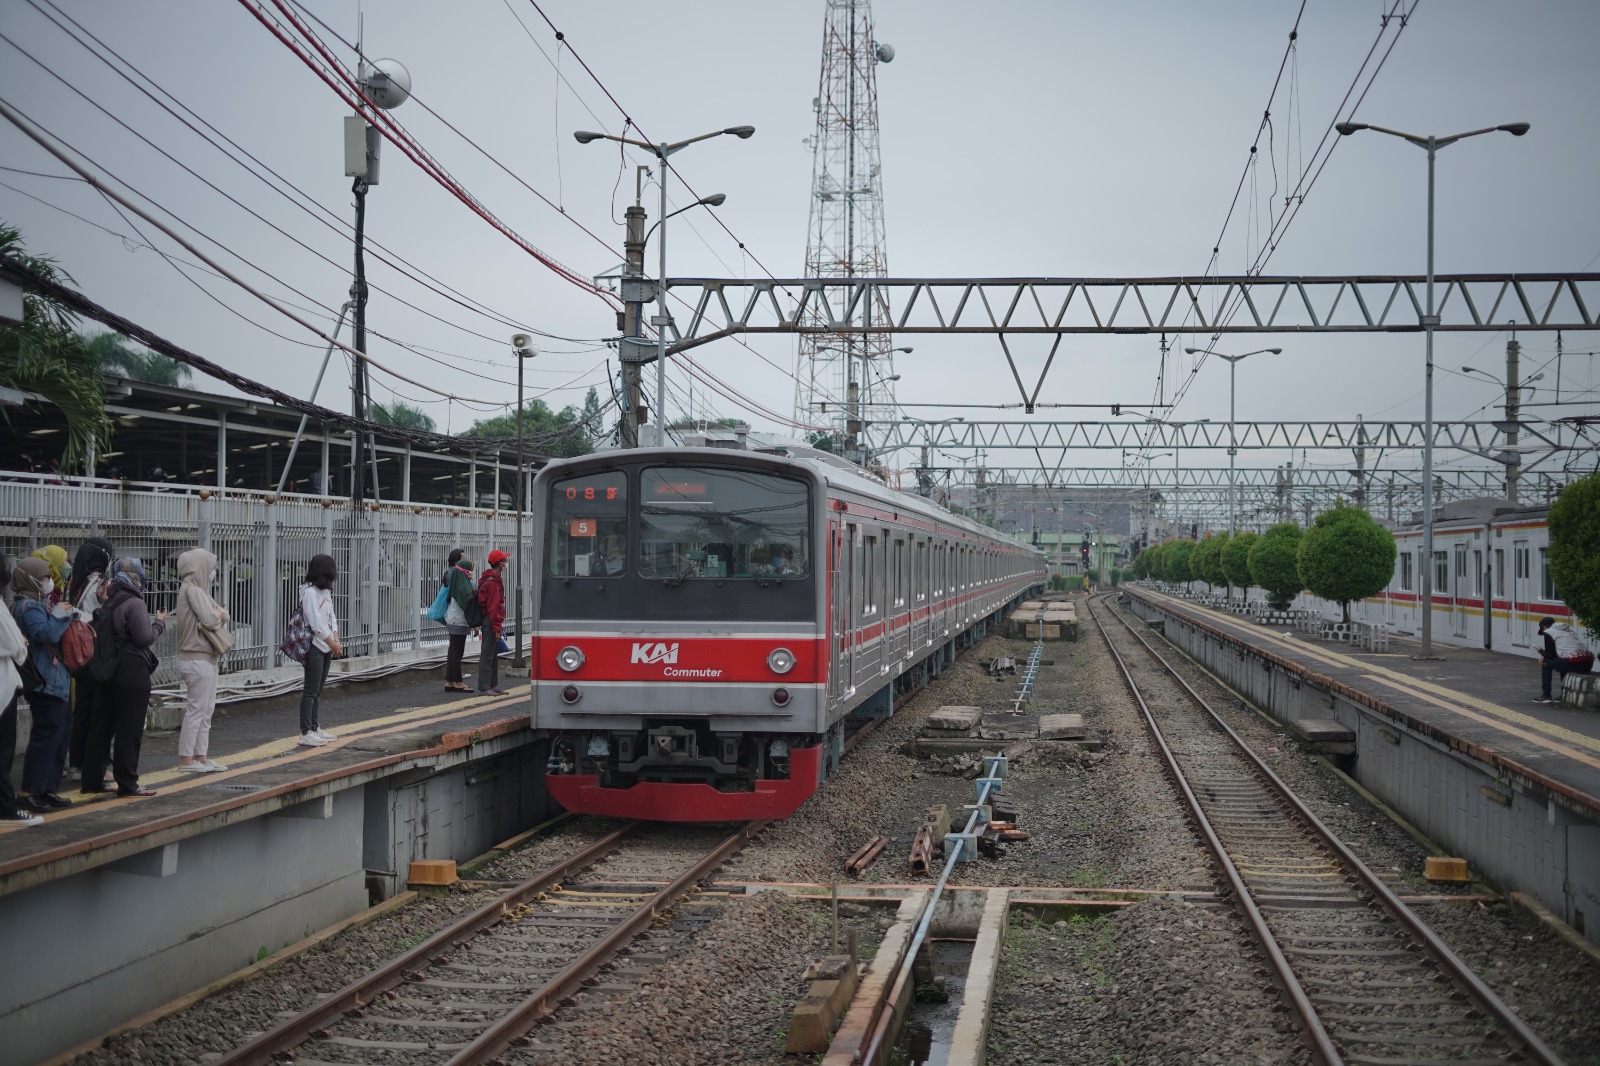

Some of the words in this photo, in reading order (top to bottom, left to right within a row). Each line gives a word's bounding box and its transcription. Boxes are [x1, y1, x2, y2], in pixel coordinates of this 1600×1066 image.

[578, 522, 588, 533] 5
[630, 642, 680, 664] KAI
[663, 666, 723, 677] Commuter
